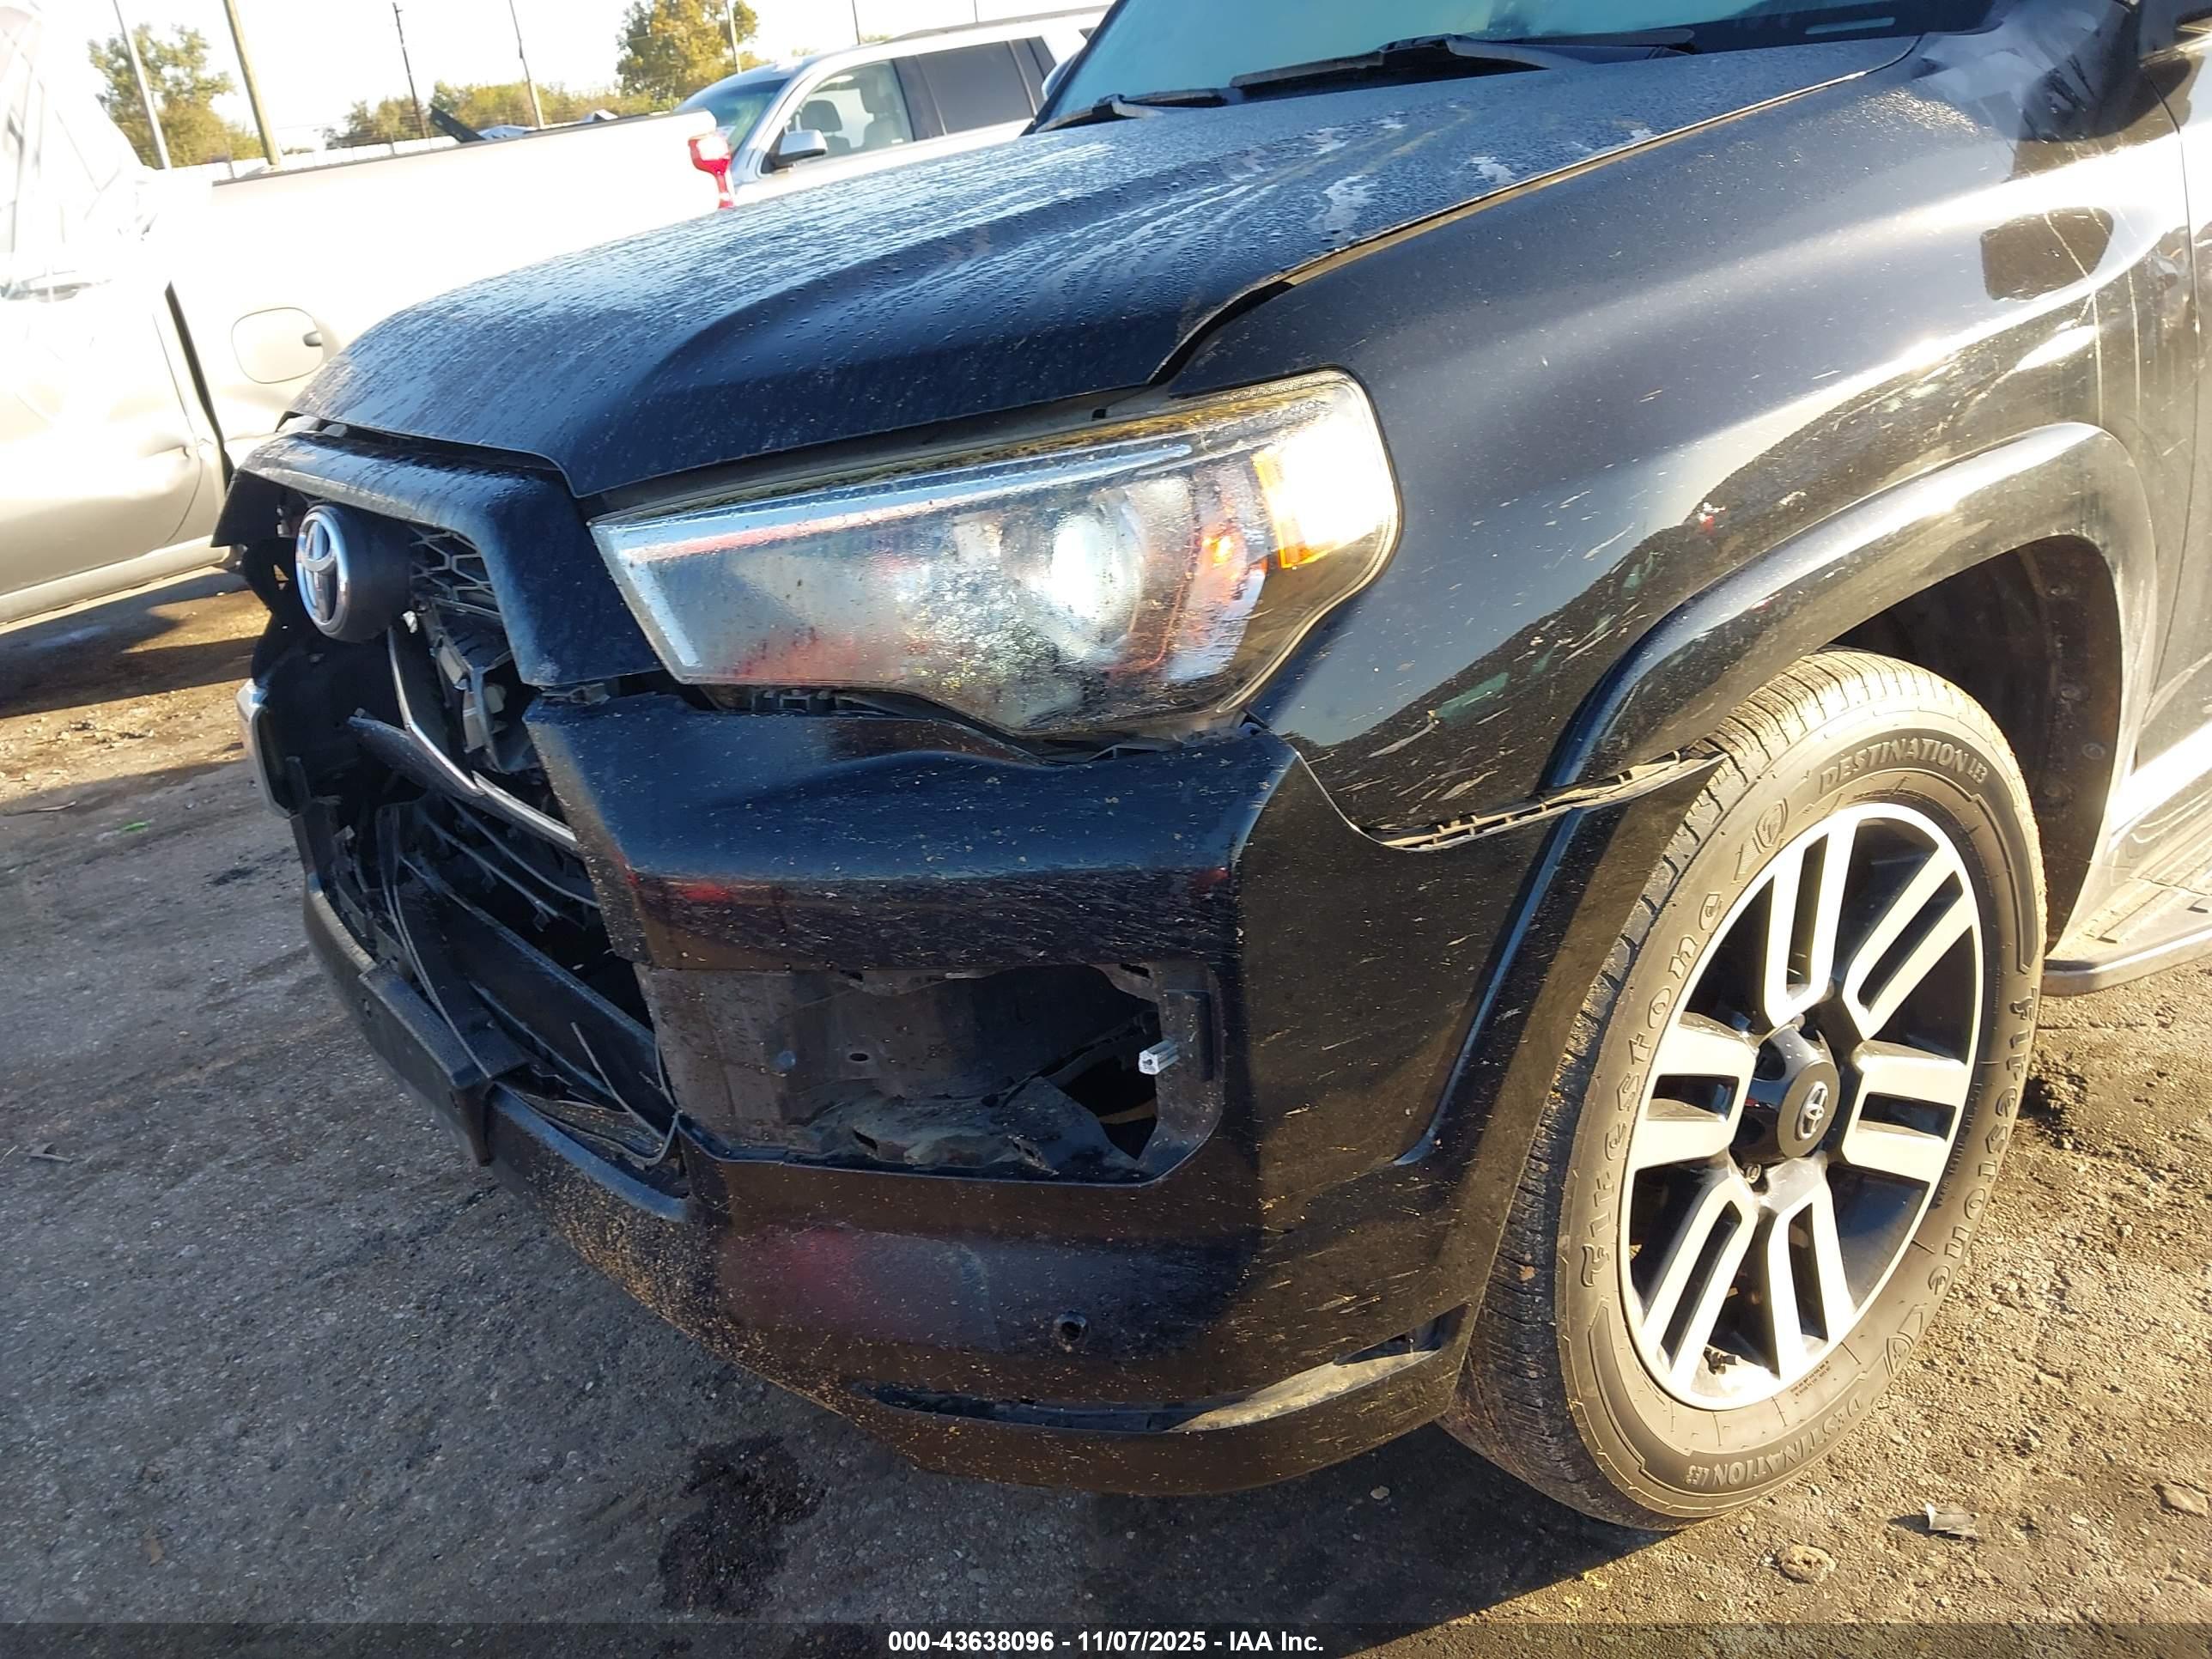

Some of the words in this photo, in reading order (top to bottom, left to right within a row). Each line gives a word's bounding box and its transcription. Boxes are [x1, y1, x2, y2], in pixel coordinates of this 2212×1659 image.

[1818, 738, 1970, 794] DESTINATION
[1580, 891, 1723, 1288] Firestone
[1928, 987, 2039, 1296] Firestone
[1715, 1397, 1863, 1487] DESTINATION
